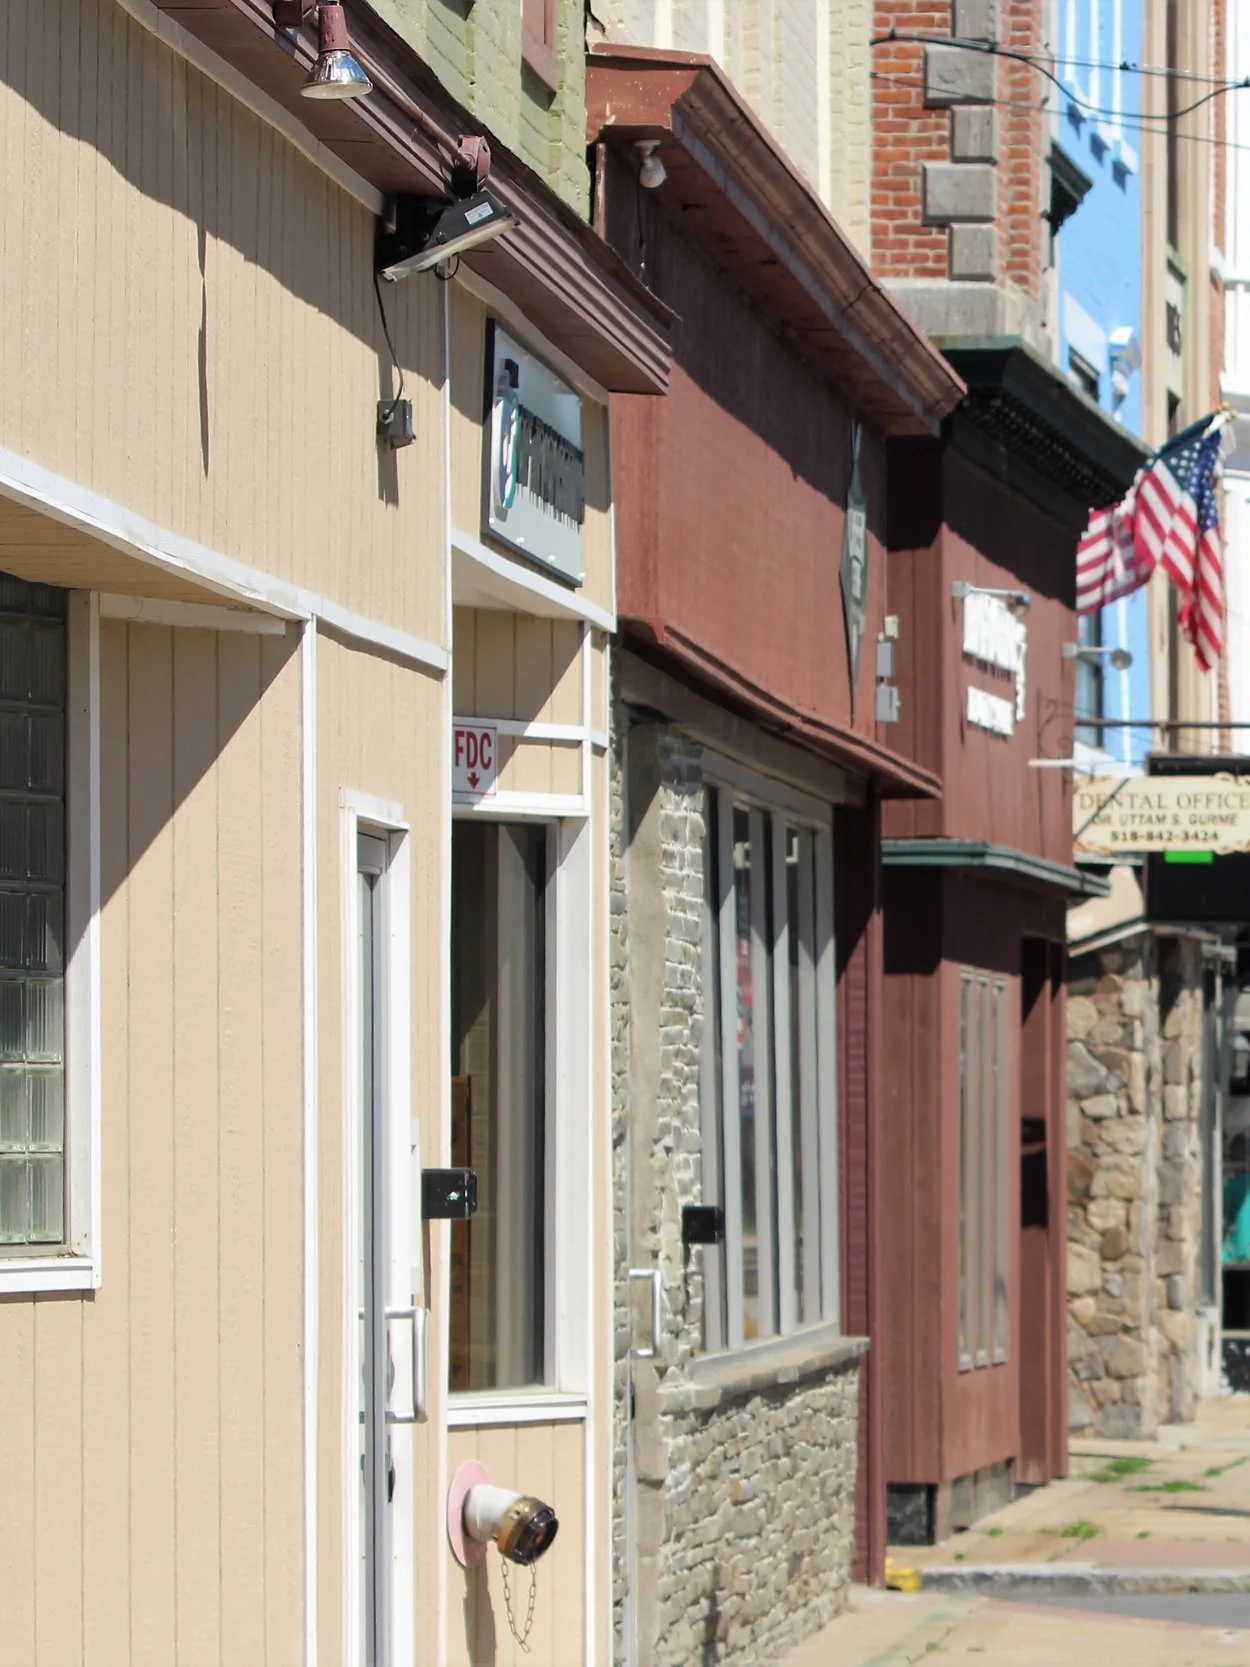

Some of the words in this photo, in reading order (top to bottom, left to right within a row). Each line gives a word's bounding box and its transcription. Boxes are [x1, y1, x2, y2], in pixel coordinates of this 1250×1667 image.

[454, 730, 492, 771] FDC
[1079, 793, 1168, 810] DENTAL
[1177, 792, 1250, 810] OFFICE
[1120, 813, 1166, 826] UTTAM
[1110, 831, 1219, 843] 518-842-3424
